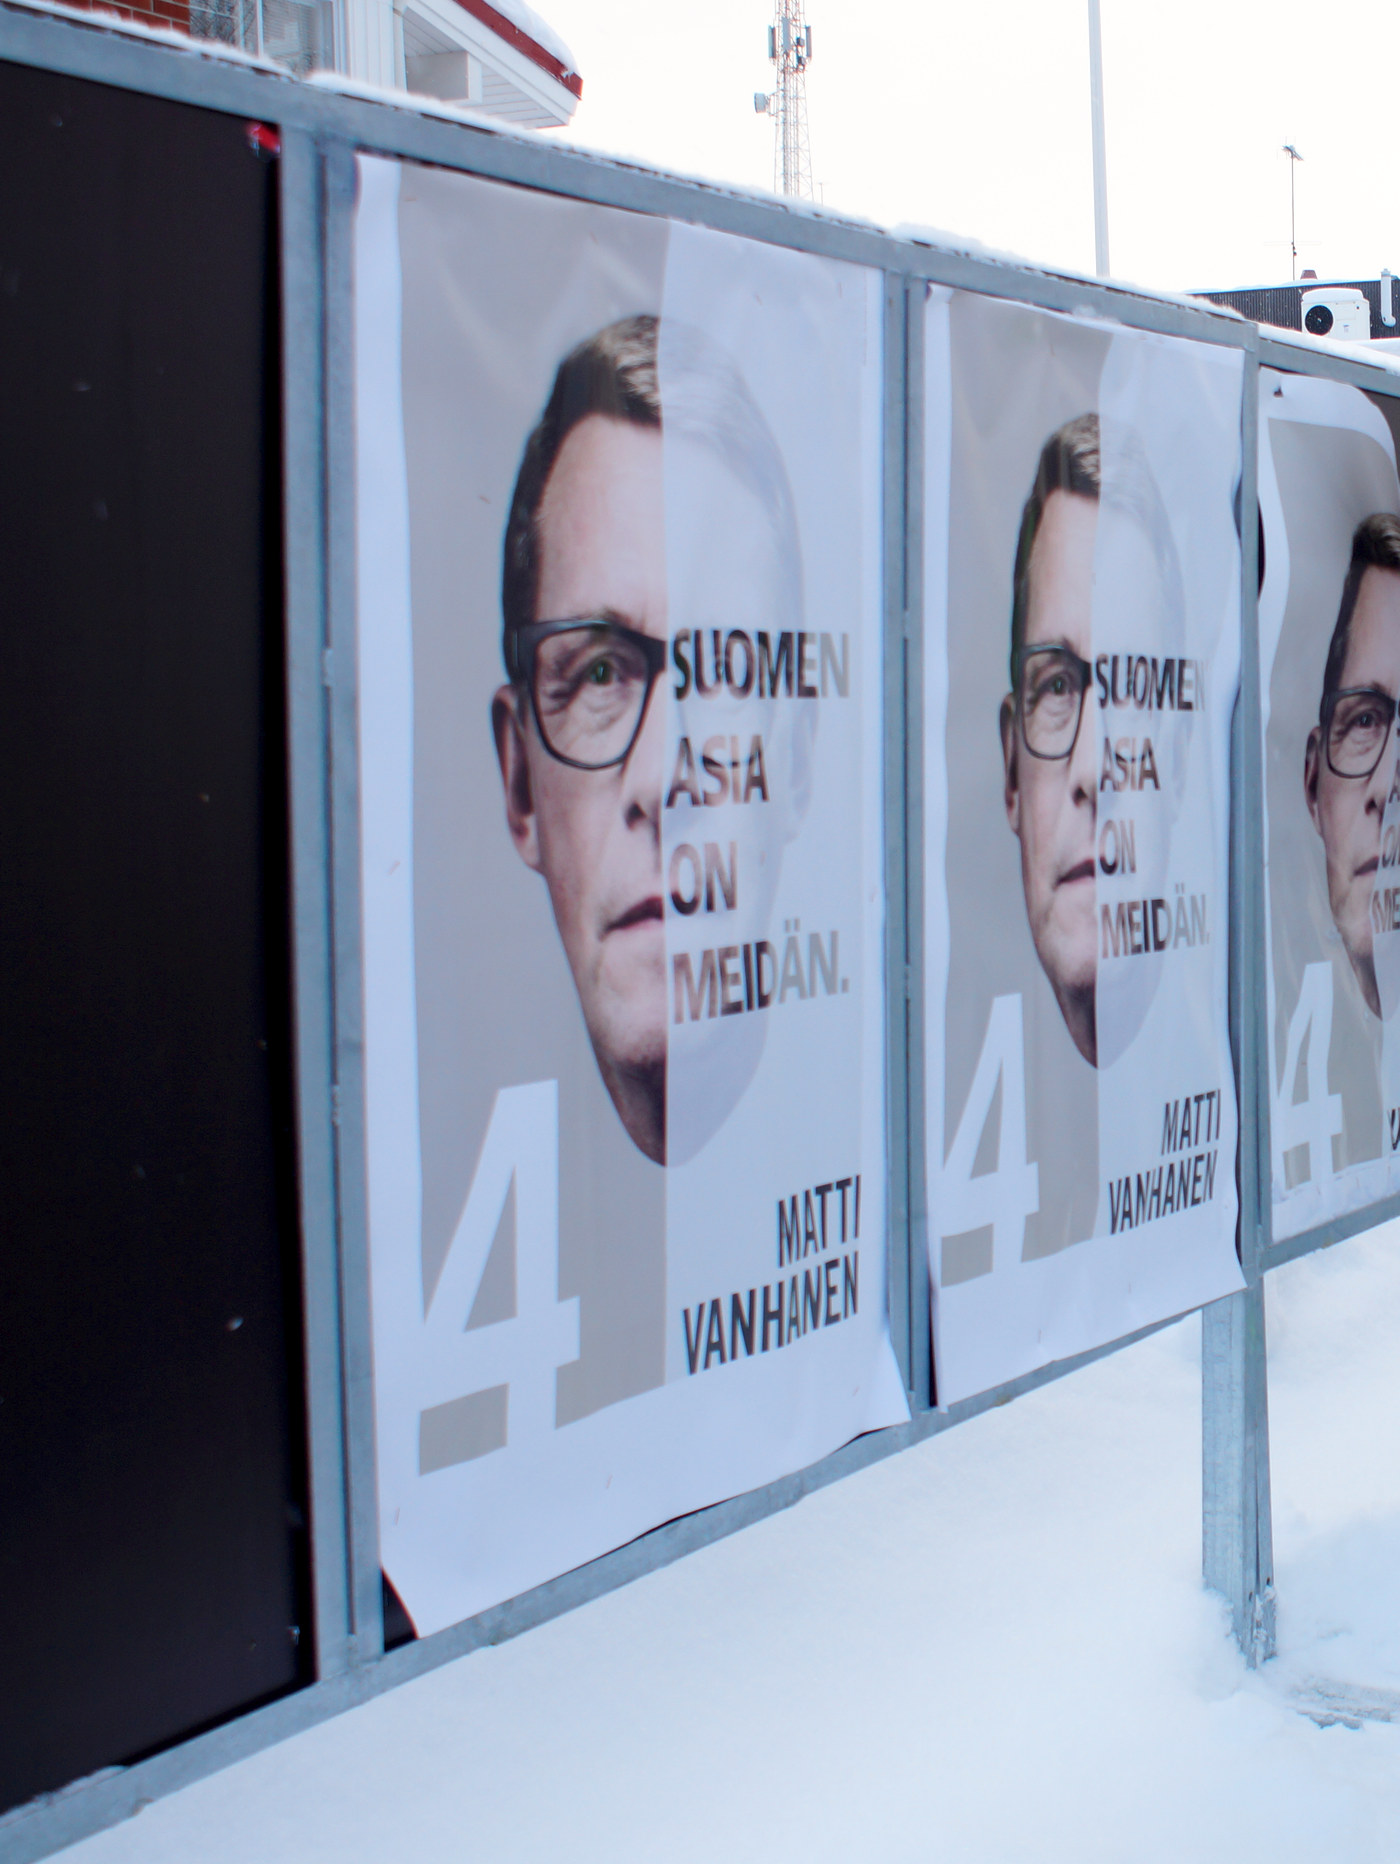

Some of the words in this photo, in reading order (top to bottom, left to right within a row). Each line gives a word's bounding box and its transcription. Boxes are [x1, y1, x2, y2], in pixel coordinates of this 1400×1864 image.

[673, 628, 849, 701] SUOMEN
[665, 734, 770, 808] ASIA
[1100, 736, 1161, 792] ASIA
[669, 840, 738, 916] ON
[1099, 818, 1136, 876] ON
[1101, 882, 1210, 960] MEIDÄN.
[672, 918, 849, 1025] MEIDÄN.
[1277, 960, 1343, 1188] 4
[939, 992, 1040, 1264] 4
[1161, 1088, 1221, 1156] MATTI
[777, 1174, 861, 1269] MATTI
[1109, 1149, 1218, 1235] VANHANEN
[420, 1078, 581, 1446] 4
[682, 1250, 859, 1376] VANHANEN
